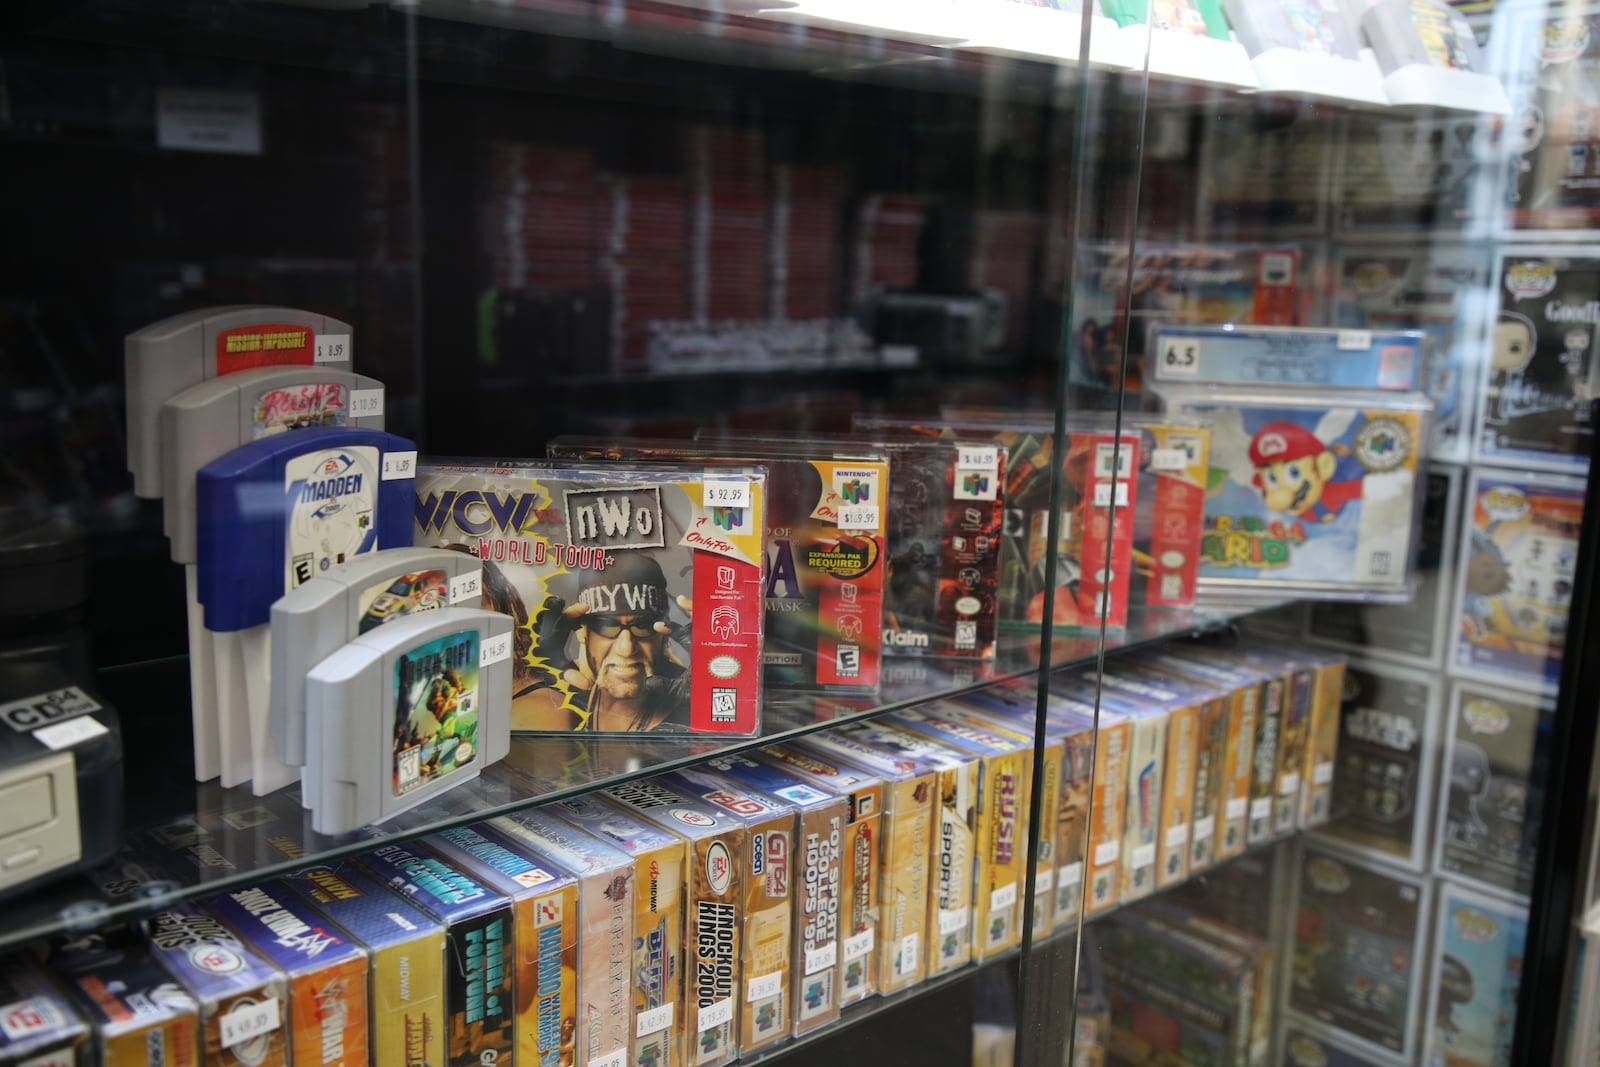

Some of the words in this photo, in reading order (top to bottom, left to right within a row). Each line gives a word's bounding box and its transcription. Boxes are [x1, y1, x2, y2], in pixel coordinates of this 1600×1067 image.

[263, 331, 308, 352] IMPOSSIBLE
[1166, 346, 1195, 366] 6.5
[300, 473, 363, 504] MADDEN
[708, 488, 714, 500] $
[413, 489, 538, 537] WCW
[576, 495, 654, 540] nWo
[774, 527, 793, 538] OF
[477, 537, 547, 565] WORLD
[554, 543, 606, 571] TOUR
[686, 531, 715, 551] Only
[712, 539, 734, 553] For
[808, 551, 847, 559] EXPANSION
[847, 551, 861, 560] PAK
[808, 557, 862, 569] REQUIRED
[295, 560, 312, 585] E
[764, 601, 801, 612] MASK
[839, 651, 857, 670] E
[8, 702, 67, 726] CD
[830, 816, 840, 862] FOX
[994, 773, 1017, 866] RUSH
[716, 856, 728, 881] EA
[753, 834, 763, 875] ocean
[767, 832, 788, 895] GT64
[805, 832, 819, 915] HOOPS
[939, 821, 952, 911] SPORTS
[650, 880, 658, 915] MIDWAY
[815, 839, 830, 943] COLLEGE
[828, 865, 839, 943] SPORT
[697, 901, 717, 959] KINGS
[716, 904, 734, 998] KNOCKOUT
[399, 955, 411, 1002] MIDWAY
[464, 927, 485, 1025] FORTUNE
[485, 917, 504, 994] WHEEL
[537, 923, 563, 996] NAGANO
[486, 996, 503, 1017] of
[697, 962, 715, 1009] 2000
[320, 1014, 346, 1066] WAR
[537, 996, 551, 1052] OLYMPICS
[551, 992, 562, 1044] WINTER
